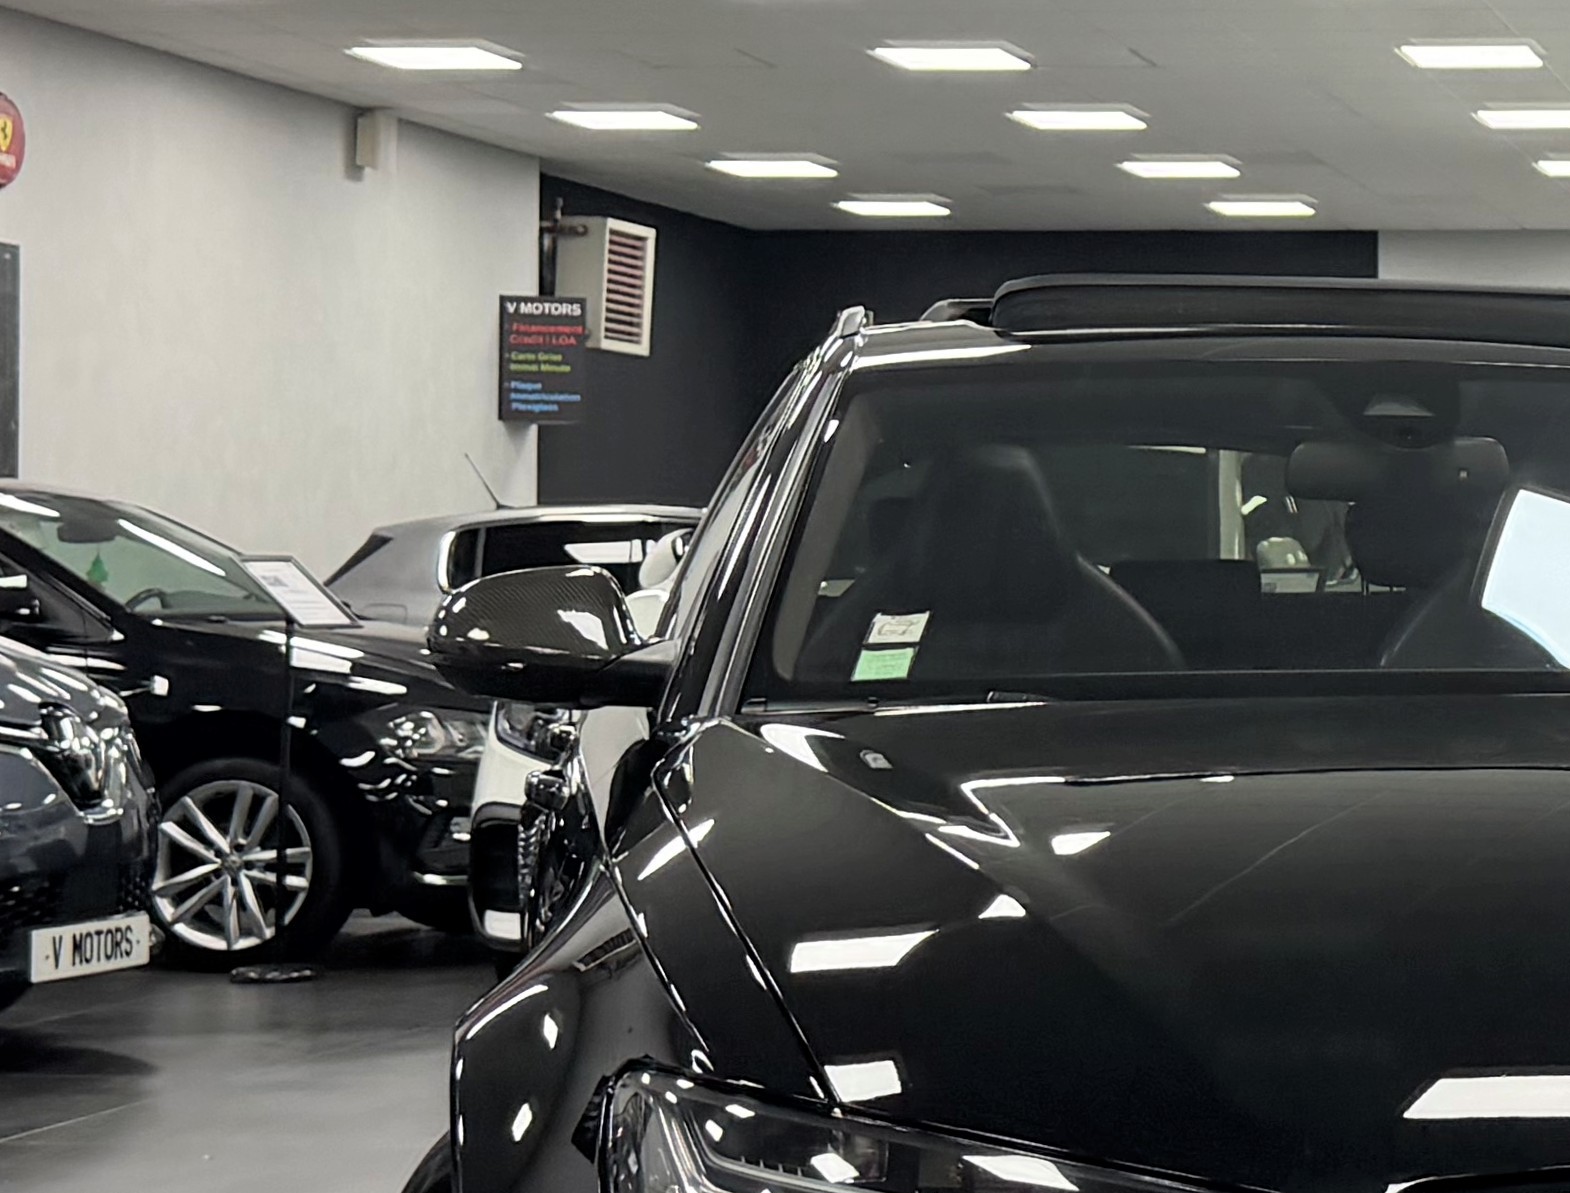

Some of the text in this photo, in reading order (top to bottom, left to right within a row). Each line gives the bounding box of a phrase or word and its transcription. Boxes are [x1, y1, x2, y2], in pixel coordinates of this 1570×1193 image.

[506, 301, 582, 316] V MOTORS
[52, 925, 133, 969] V MOTORS
